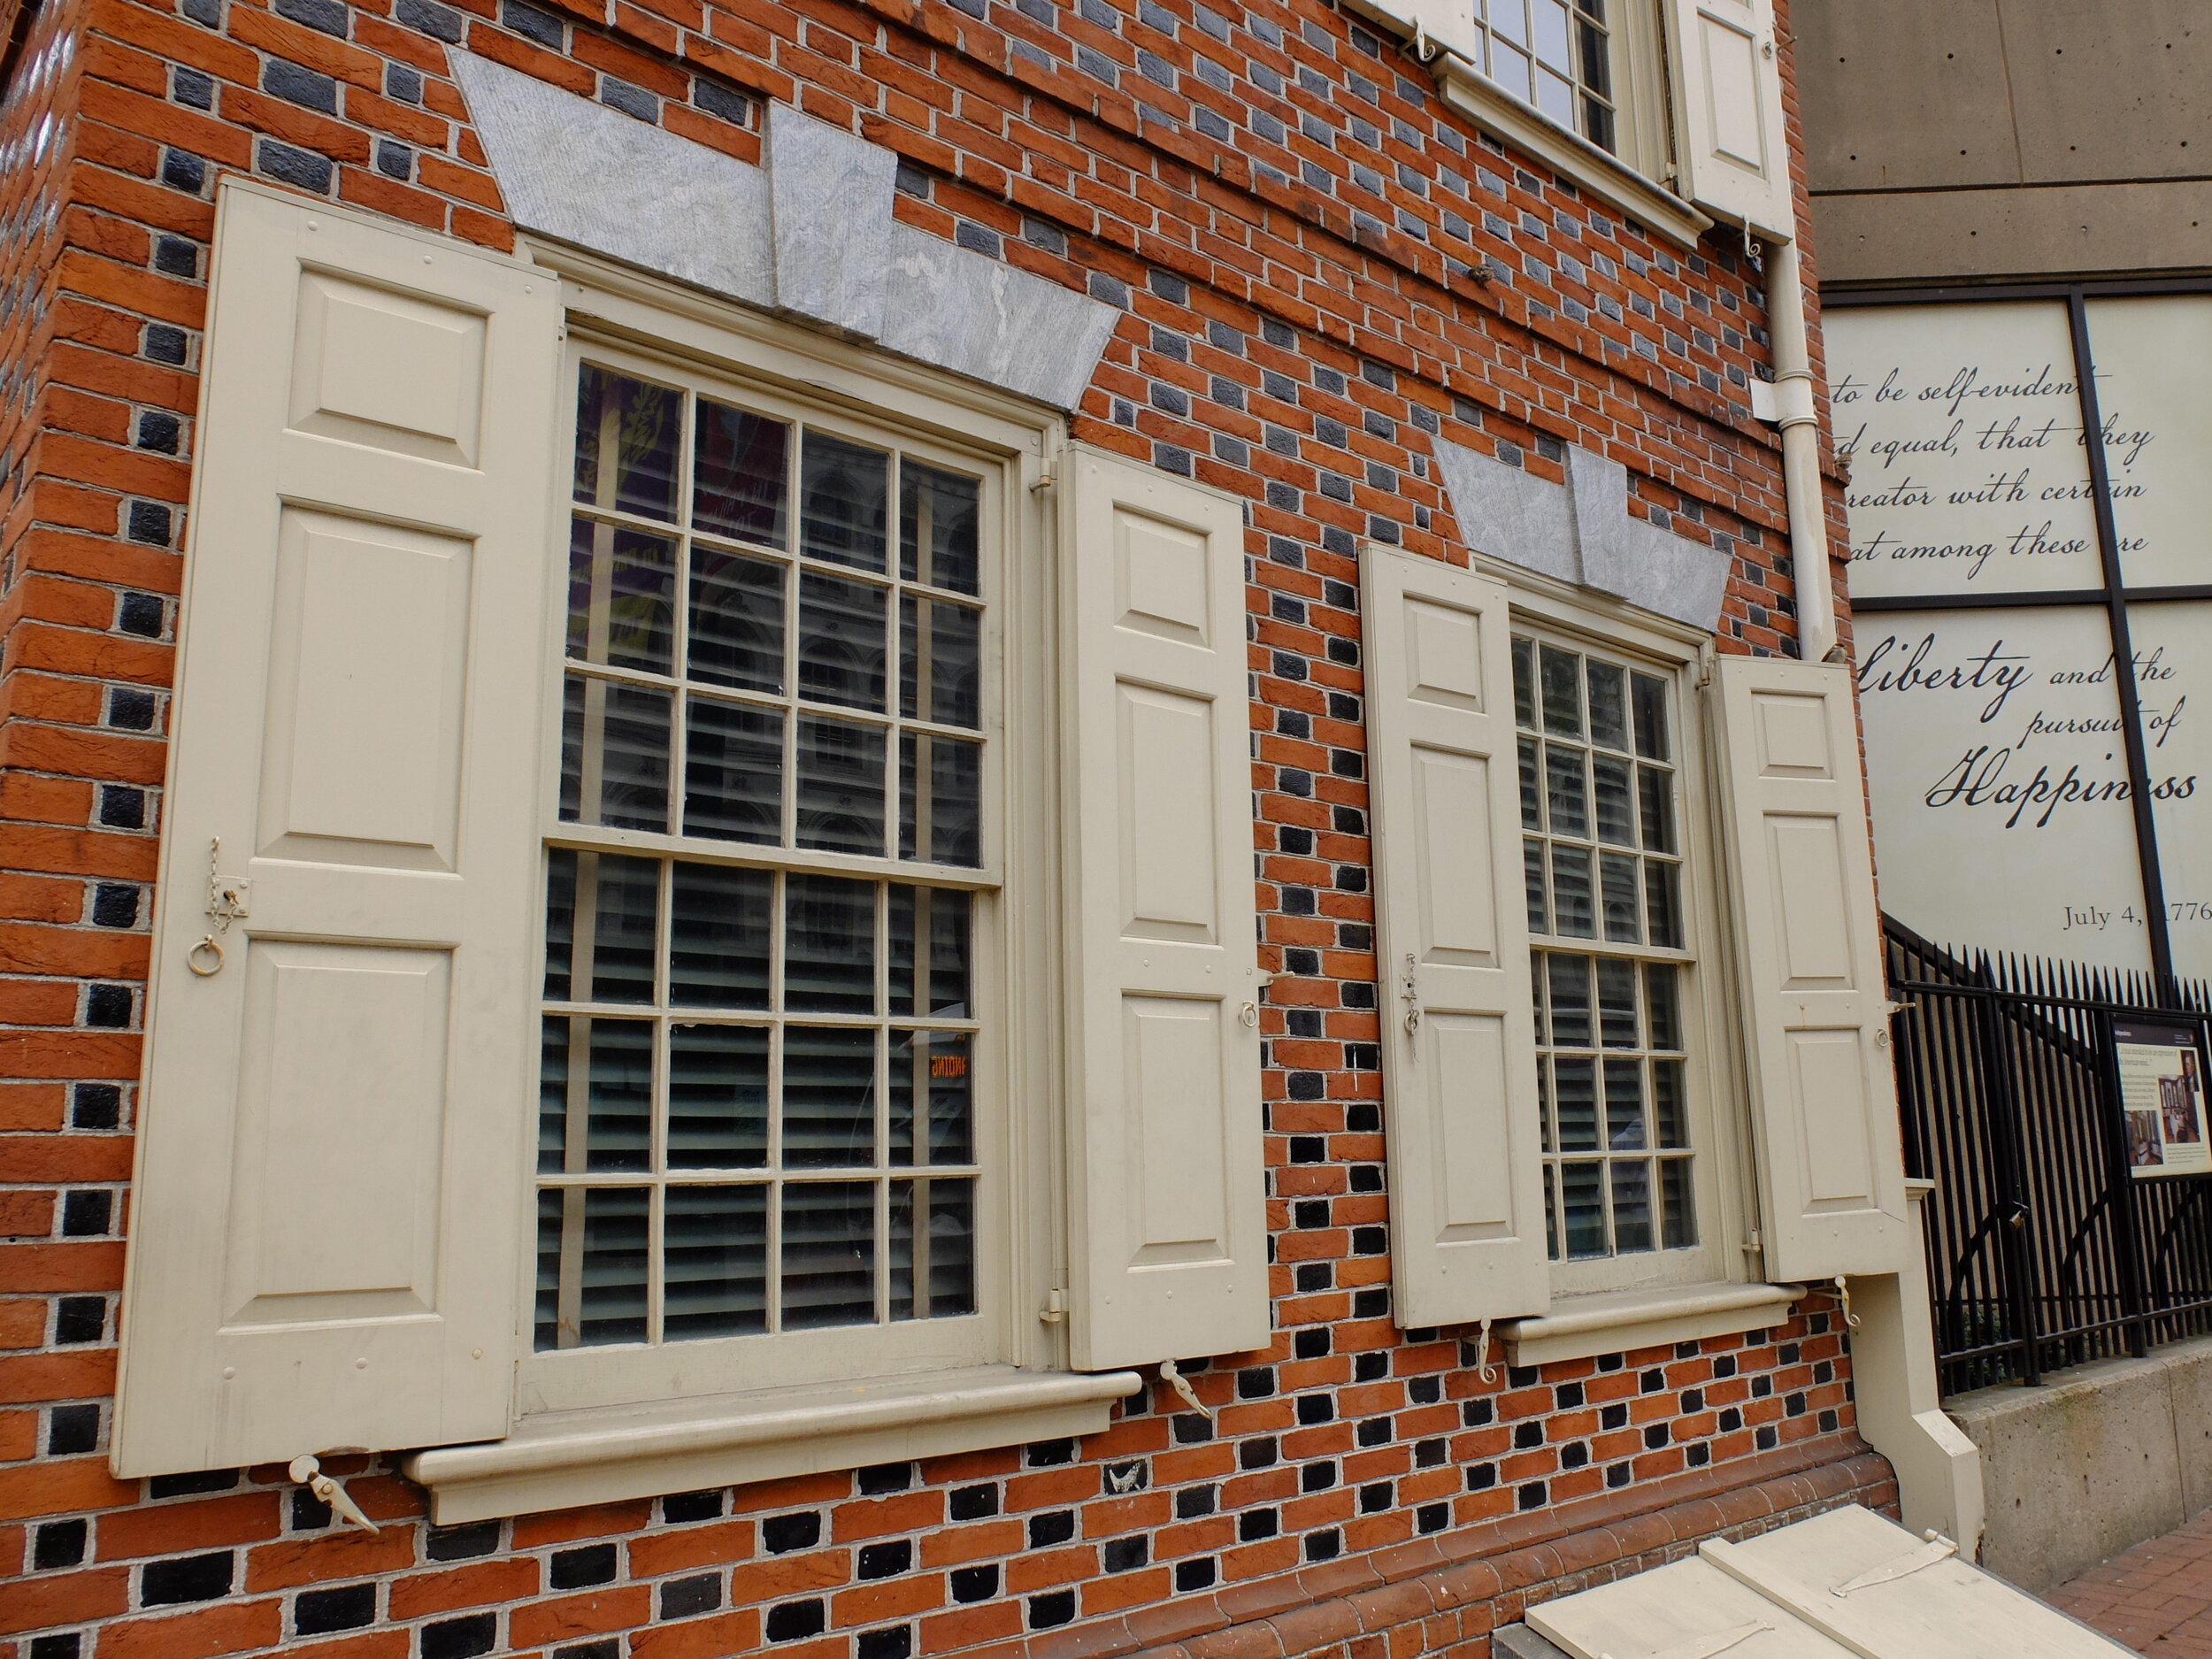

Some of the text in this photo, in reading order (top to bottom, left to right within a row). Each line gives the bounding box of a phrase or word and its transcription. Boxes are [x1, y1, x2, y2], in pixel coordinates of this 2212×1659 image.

[1830, 374, 1869, 403] to
[1876, 367, 1910, 403] be
[1870, 419, 1964, 469] equal,
[1975, 418, 2071, 450] that
[1845, 467, 2148, 509] reator with certin
[1850, 519, 2150, 580] at among these re
[2049, 650, 2115, 685] and
[2148, 695, 2186, 749] of
[1925, 745, 2198, 829] Happinss
[2062, 901, 2212, 931] July 4, 776
